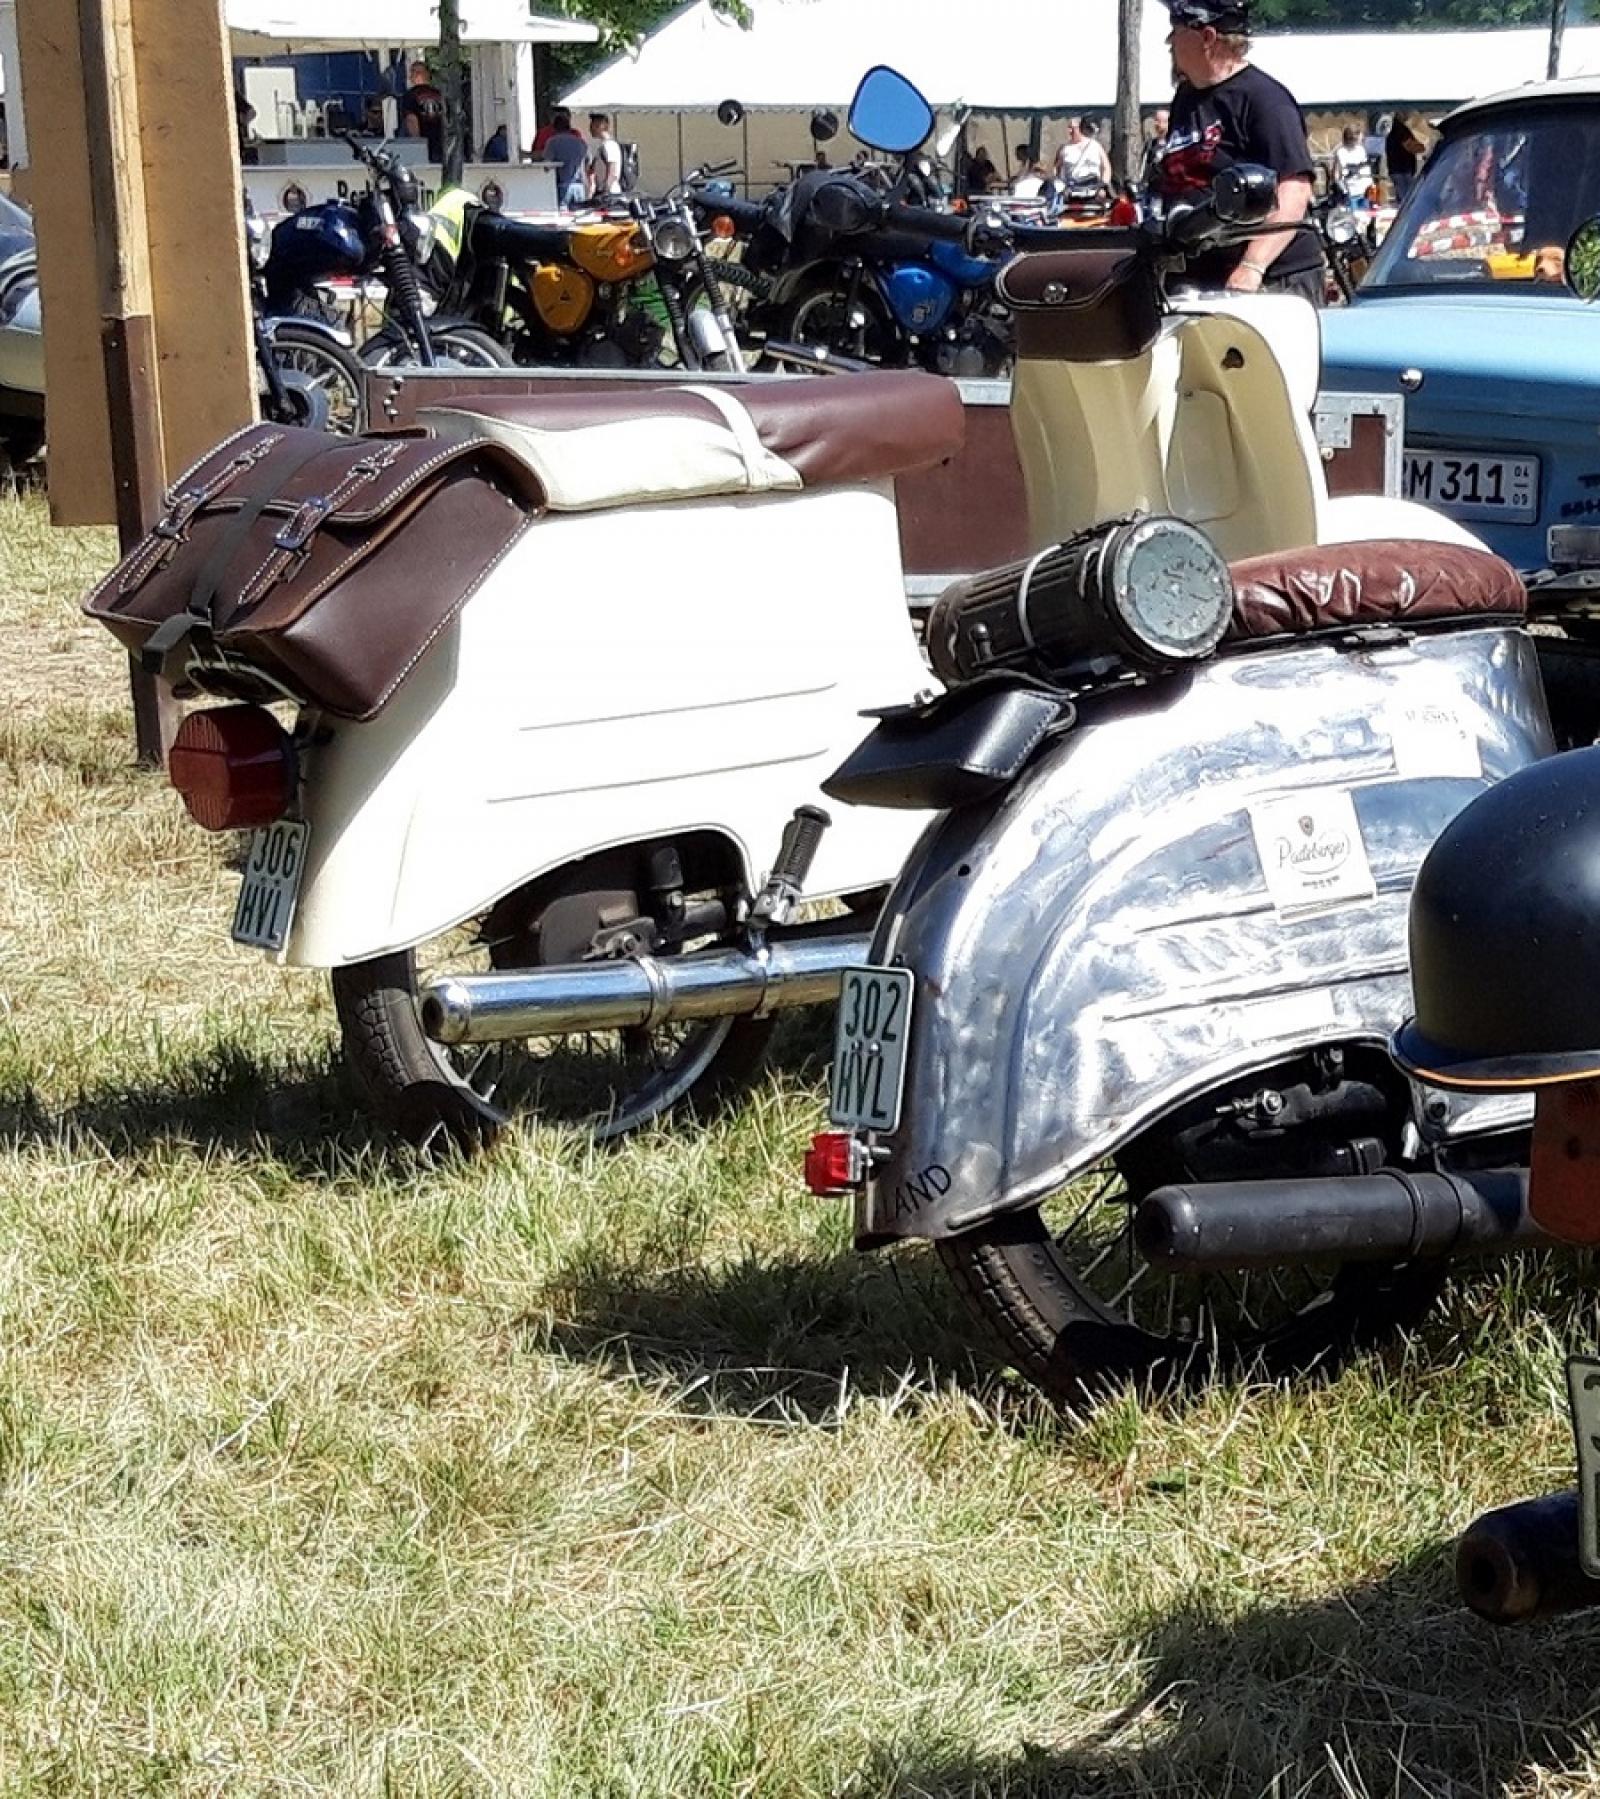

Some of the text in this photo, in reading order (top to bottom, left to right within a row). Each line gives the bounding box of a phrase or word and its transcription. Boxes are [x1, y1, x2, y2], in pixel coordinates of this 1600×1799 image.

[1439, 461, 1506, 505] 311
[1513, 465, 1530, 478] 04
[238, 885, 281, 940] HVL
[845, 976, 902, 1043] 302
[836, 1047, 889, 1119] HVL
